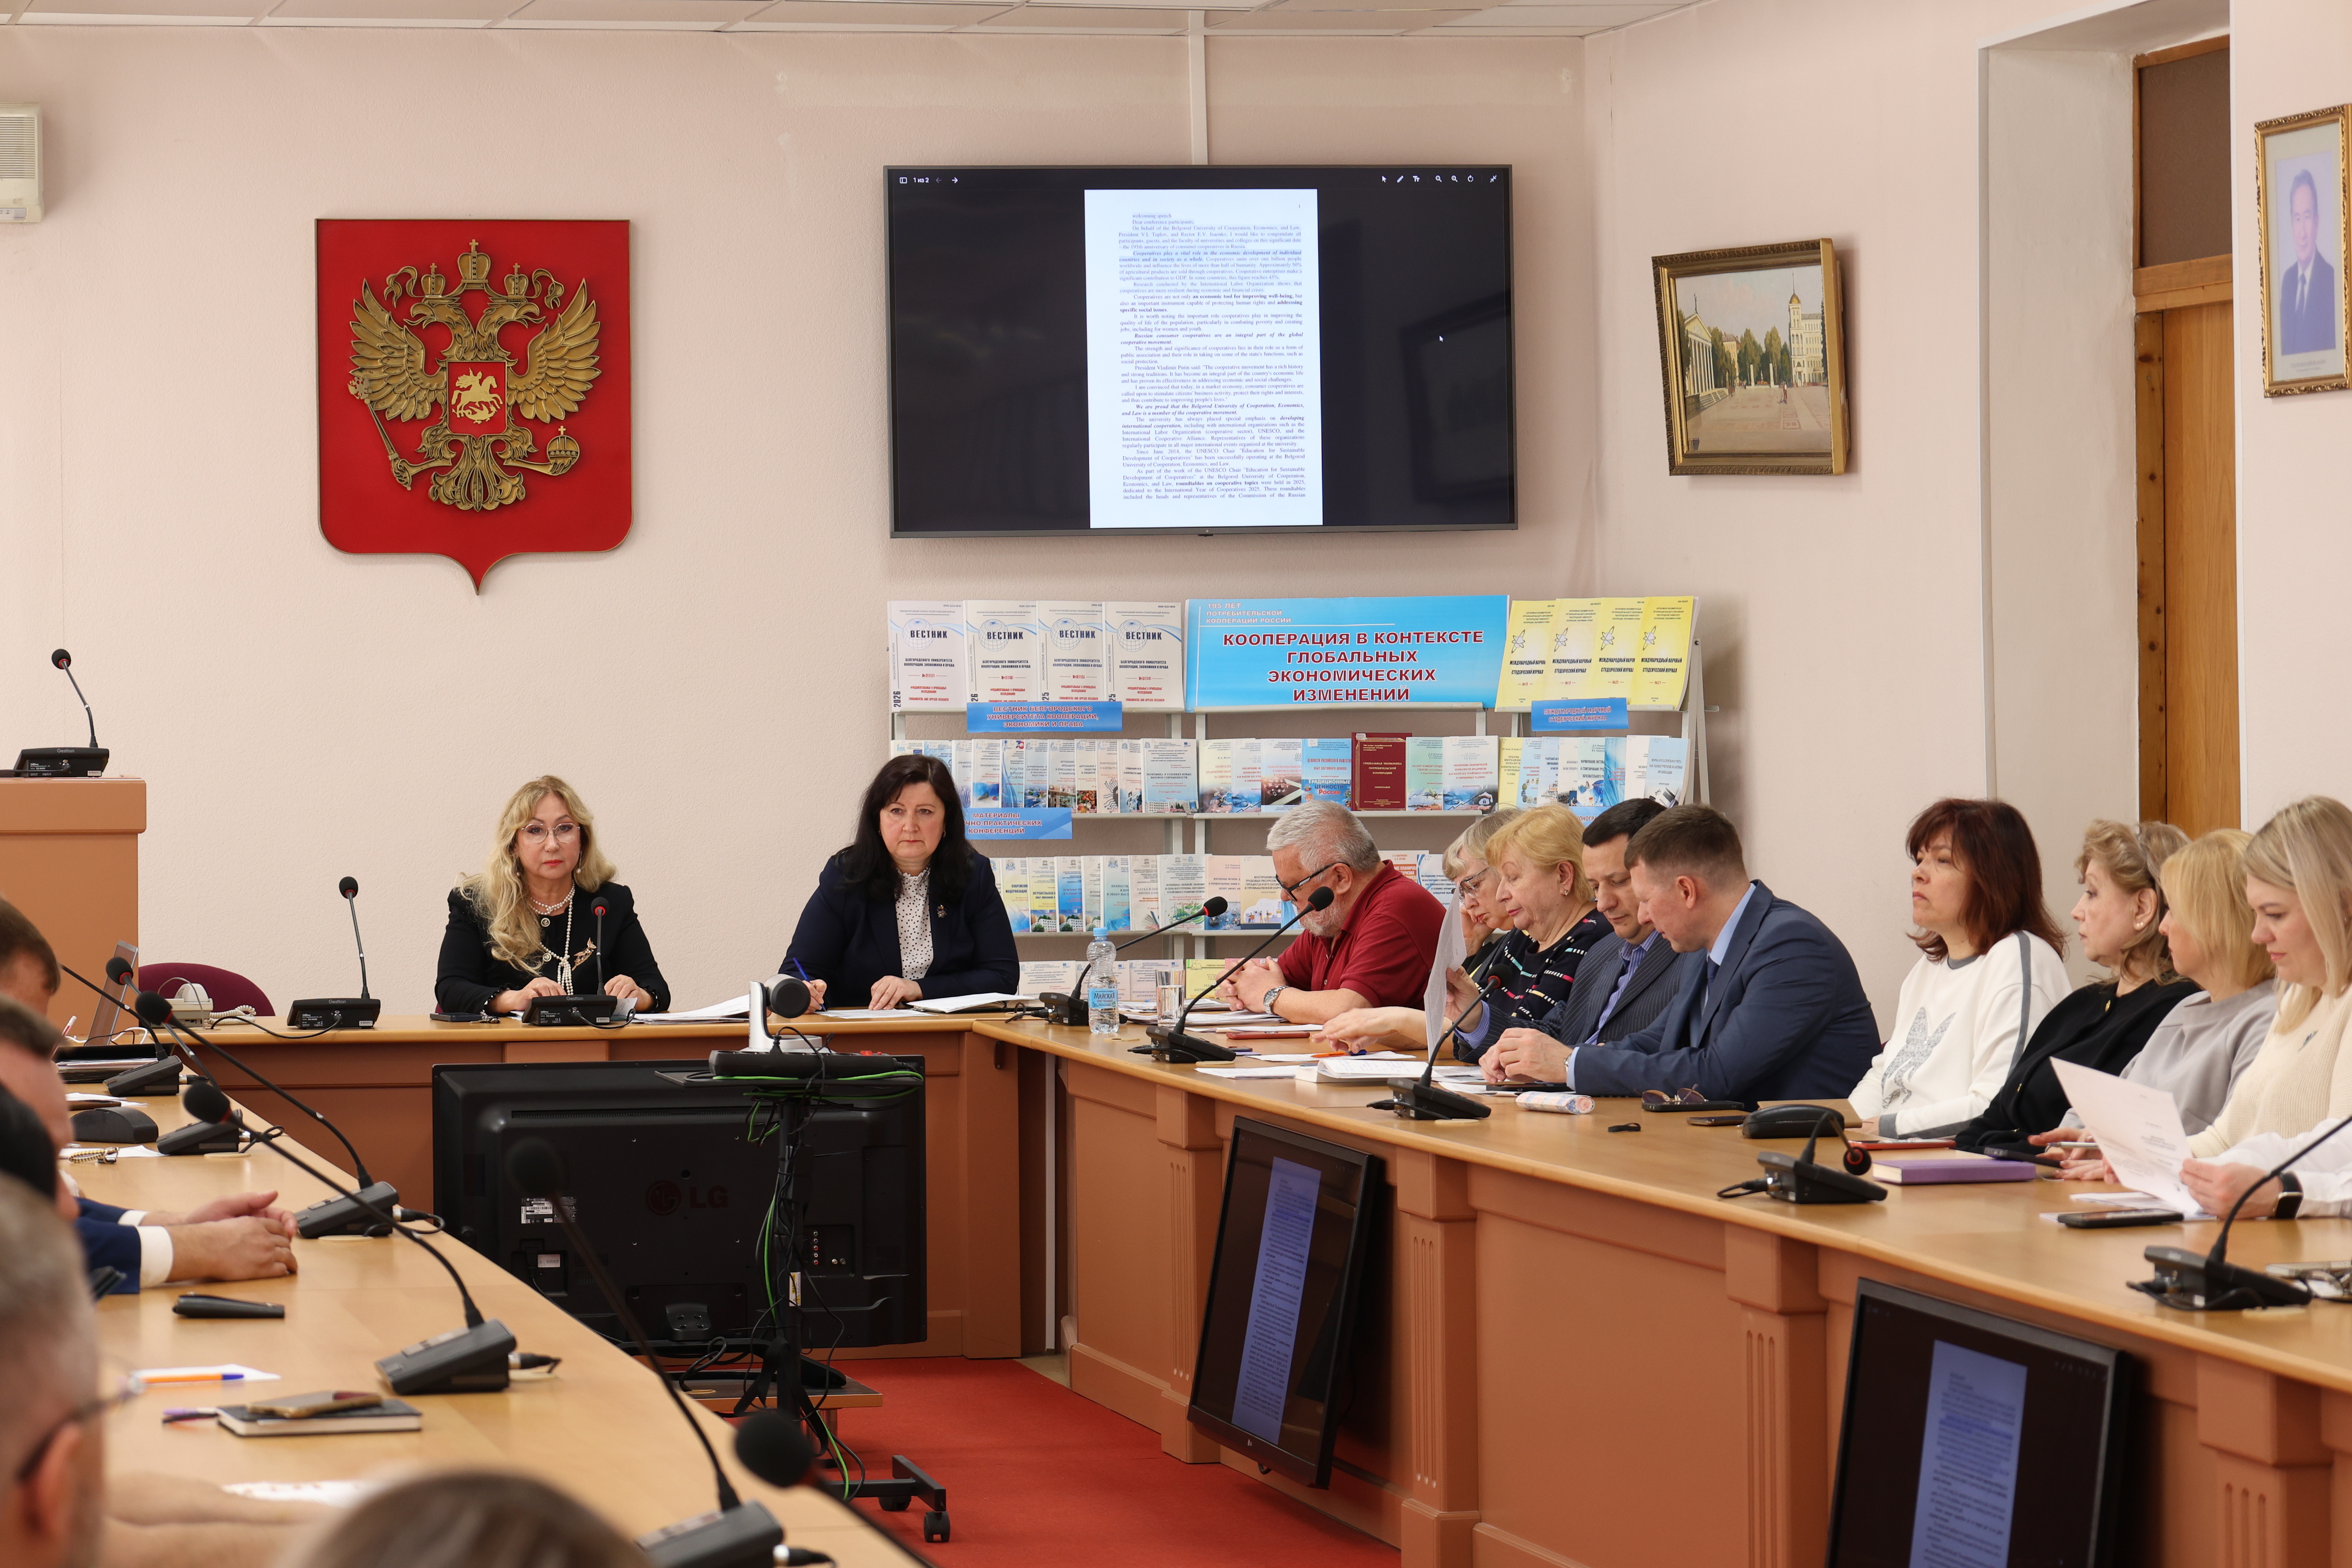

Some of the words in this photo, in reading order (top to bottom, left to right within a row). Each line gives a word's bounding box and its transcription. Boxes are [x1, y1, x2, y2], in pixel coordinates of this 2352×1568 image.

[910, 630, 947, 639] ВЕСТНИК
[1223, 633, 1350, 648] КООПЕРАЦИЯ
[1356, 632, 1368, 644] В
[1374, 631, 1483, 644] КОНТЕКСТЕ
[1287, 650, 1418, 664] ГЛОБАЛЬНЫХ
[1268, 668, 1437, 683] ЭКОНОМИЧЕСКИХ
[1293, 685, 1410, 702] ИЗМЕНЕНИЙ
[1544, 707, 1587, 715] МЕЖДУНАРОДНЫЙ
[1549, 714, 1585, 723] СТУДЕНЧЕСКИЙ
[690, 1186, 729, 1209] LG
